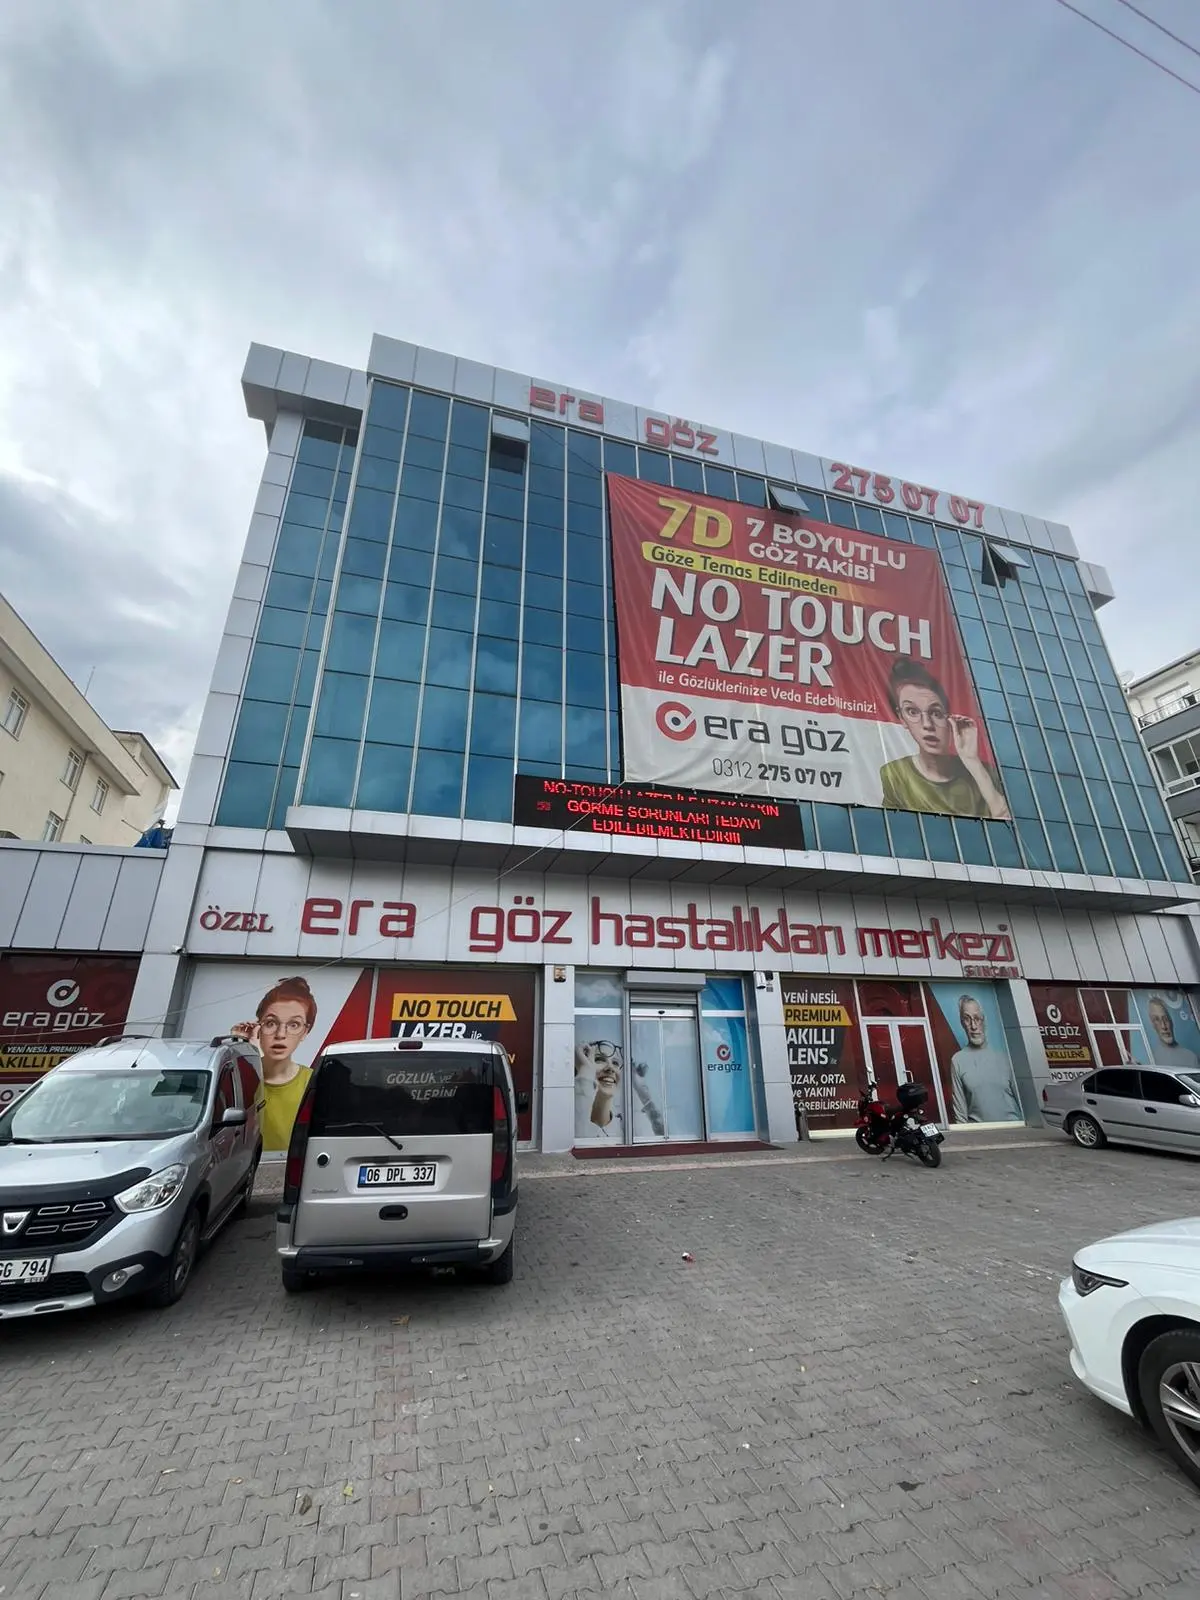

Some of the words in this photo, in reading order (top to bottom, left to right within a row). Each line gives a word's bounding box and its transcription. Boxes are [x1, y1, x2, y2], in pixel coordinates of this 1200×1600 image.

[530, 386, 604, 424] era
[646, 417, 719, 455] göz
[831, 463, 895, 503] 275
[901, 482, 939, 515] 07
[950, 495, 985, 528] 07
[658, 497, 732, 549] 7D
[747, 517, 764, 539] 7
[772, 523, 906, 570] BOYUTLU
[651, 545, 694, 570] Göze
[701, 556, 753, 580] Temas
[759, 568, 838, 596] Edilmeden
[748, 538, 799, 567] GÖZ
[803, 553, 875, 582] TAKİBİ
[651, 568, 740, 621] NO
[761, 588, 931, 658] TOUCH
[655, 616, 834, 687] LAZER
[658, 671, 675, 685] ile
[679, 673, 768, 697] Gözlüklerinize
[771, 687, 801, 704] Veda
[805, 692, 877, 714] Edebilirsiniz!
[704, 714, 770, 745] era
[781, 720, 850, 756] göz
[712, 758, 753, 780] 0312
[758, 763, 791, 782] 275
[795, 768, 816, 785] 07
[820, 770, 842, 788] 07
[199, 904, 273, 933] ÖZEL
[300, 897, 417, 938] era
[469, 895, 573, 953] göz
[591, 896, 846, 956] hastalıkları
[856, 917, 1016, 962] merkezi
[783, 990, 808, 1004] YENİ
[810, 990, 840, 1004] NESİL
[2, 1012, 51, 1027] era
[52, 1007, 105, 1031] göz
[399, 1000, 431, 1018] NO
[436, 1000, 502, 1018] TOUCH
[785, 1009, 841, 1022] PREMIUM
[398, 1022, 467, 1039] LAZER
[786, 1028, 835, 1045] AKILLI
[26, 1045, 48, 1054] NESİL
[789, 1048, 828, 1065] LENS
[708, 1063, 724, 1071] era
[1051, 1071, 1063, 1080] NO
[820, 1073, 846, 1084] ORTA
[804, 1087, 836, 1098] YAKINI
[367, 1168, 380, 1182] 06
[386, 1168, 406, 1182] DPL
[413, 1166, 434, 1181] 337
[19, 1260, 48, 1277] 794
